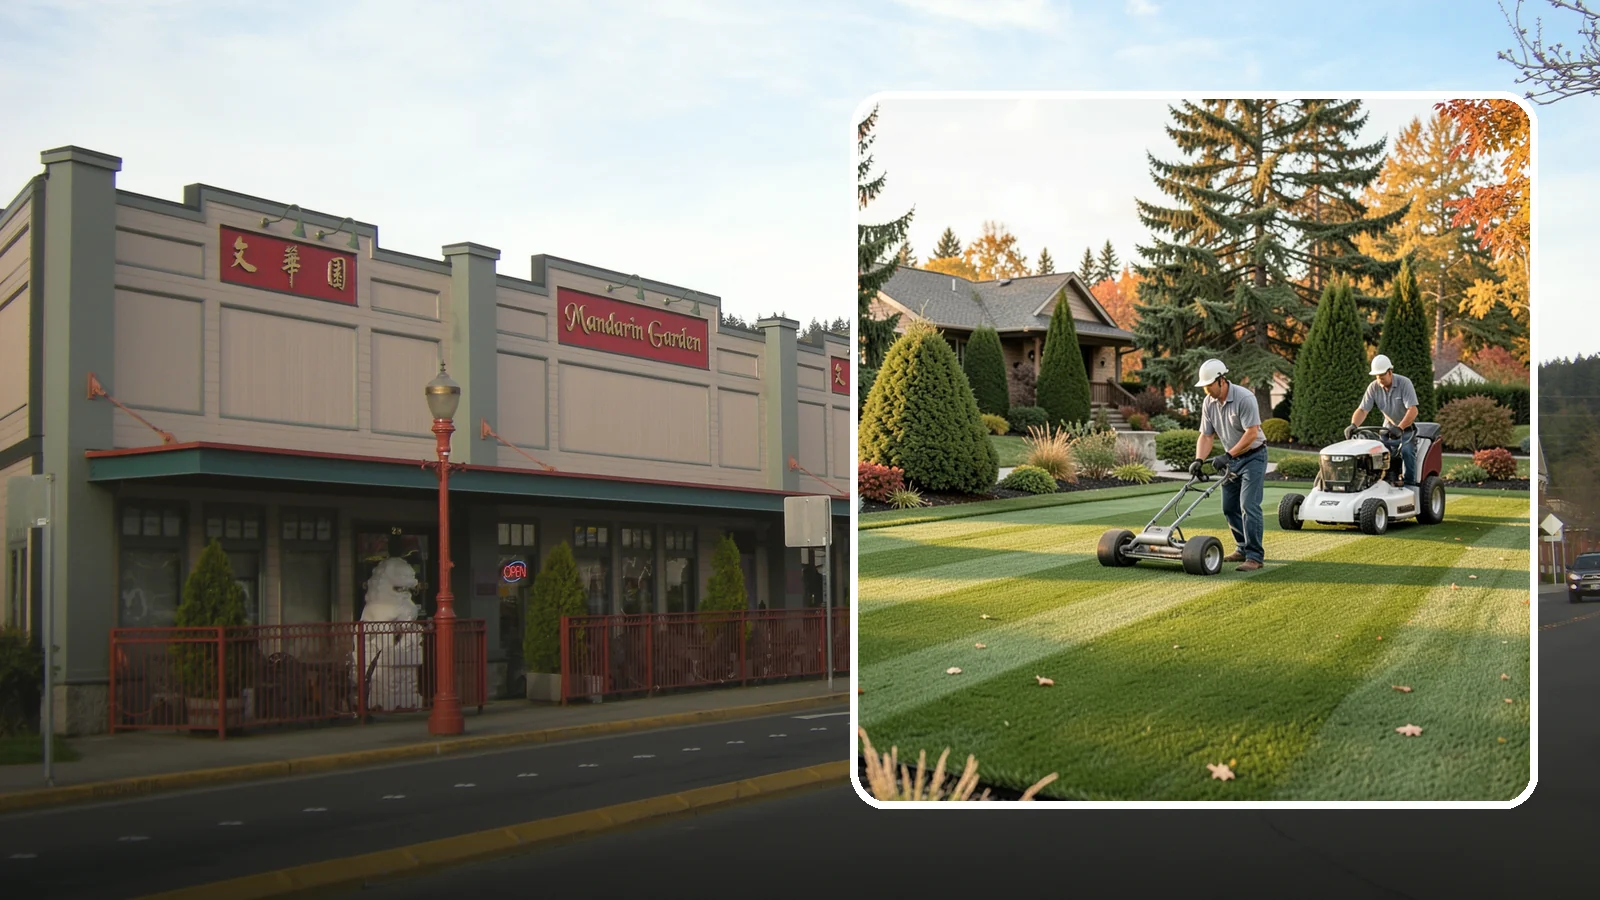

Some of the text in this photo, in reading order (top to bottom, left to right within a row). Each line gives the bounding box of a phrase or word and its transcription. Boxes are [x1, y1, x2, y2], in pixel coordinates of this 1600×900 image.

[564, 302, 701, 352] Mandarin Garden
[503, 565, 527, 578] OPEN
